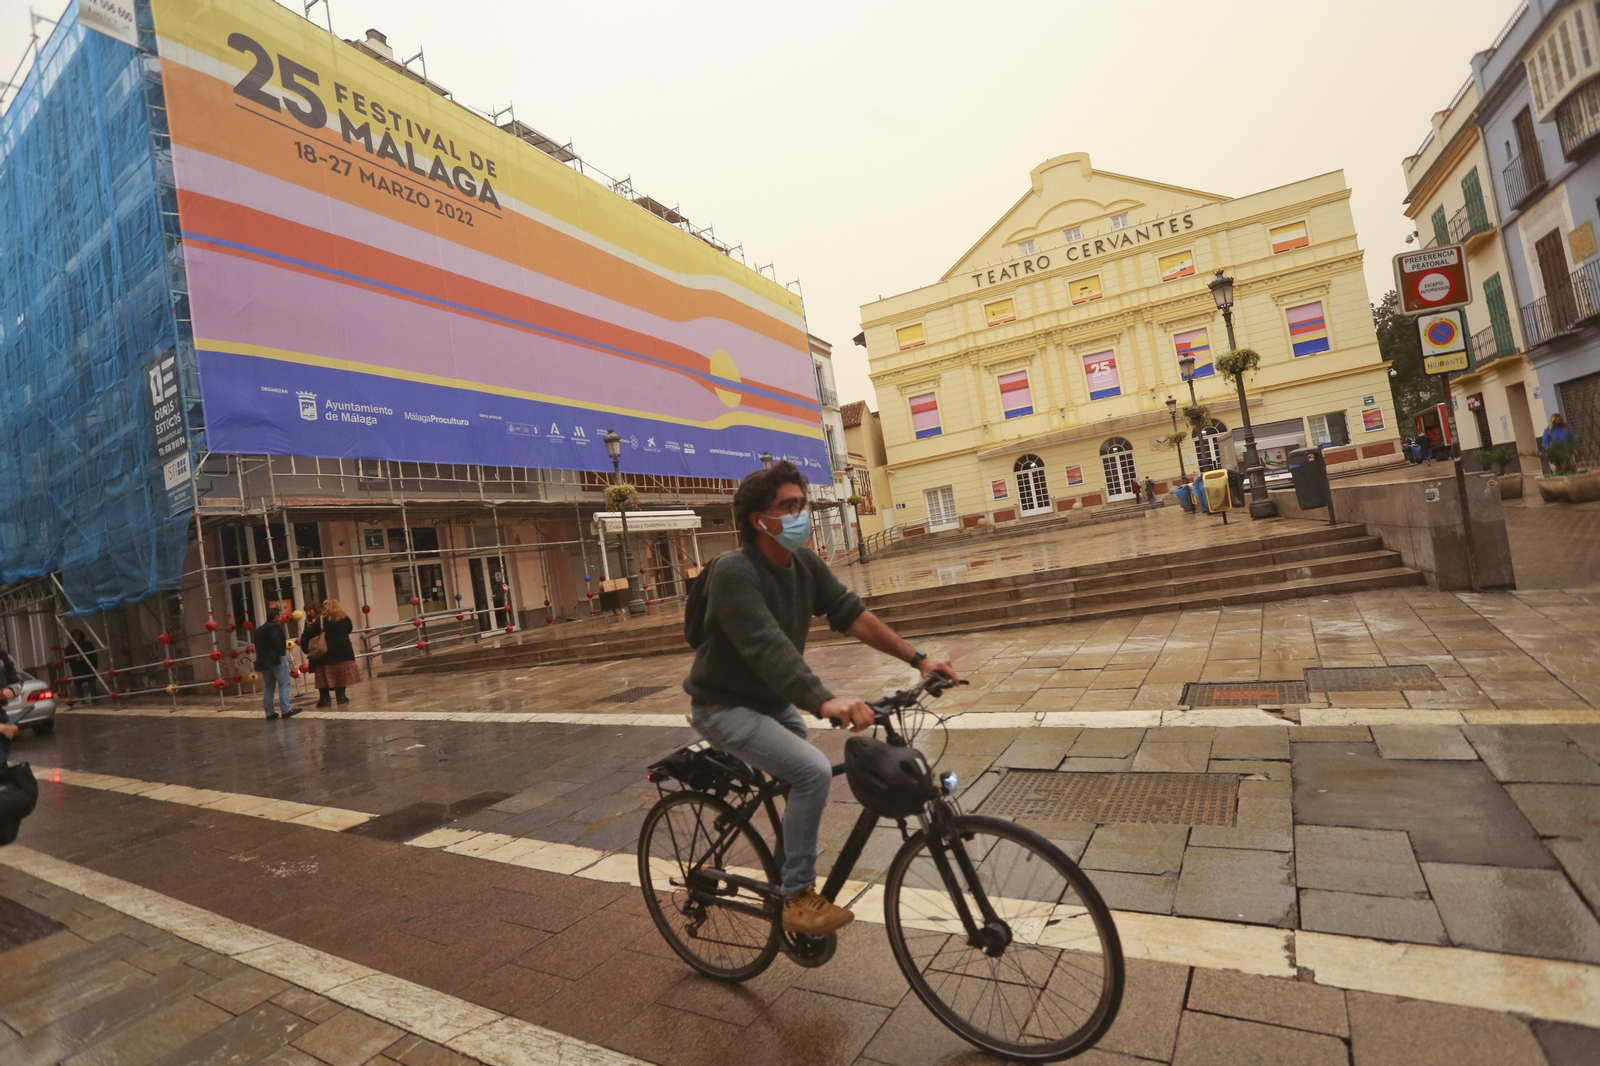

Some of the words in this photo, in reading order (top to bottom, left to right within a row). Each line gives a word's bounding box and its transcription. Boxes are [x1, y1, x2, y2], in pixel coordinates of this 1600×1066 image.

[227, 32, 328, 129] 25
[334, 81, 461, 161] FESTIVAL
[470, 150, 497, 179] DE
[338, 108, 502, 210] MÁLAGA
[294, 141, 352, 177] 18-27
[359, 166, 430, 208] MARZO
[434, 198, 474, 227] 2022
[972, 255, 1050, 287] TEATRO
[1066, 214, 1194, 261] CERVANTES
[1404, 250, 1455, 264] PREFERENCIA
[1411, 259, 1449, 271] PEATONAL
[1420, 285, 1450, 294] AUTORIZADOS
[1090, 361, 1111, 378] 25
[1427, 357, 1465, 370] HIDRANTE
[325, 399, 393, 416] Ayuntamiento
[325, 411, 338, 421] de
[341, 412, 378, 426] Málaga
[404, 411, 469, 426] MálagaProcultura
